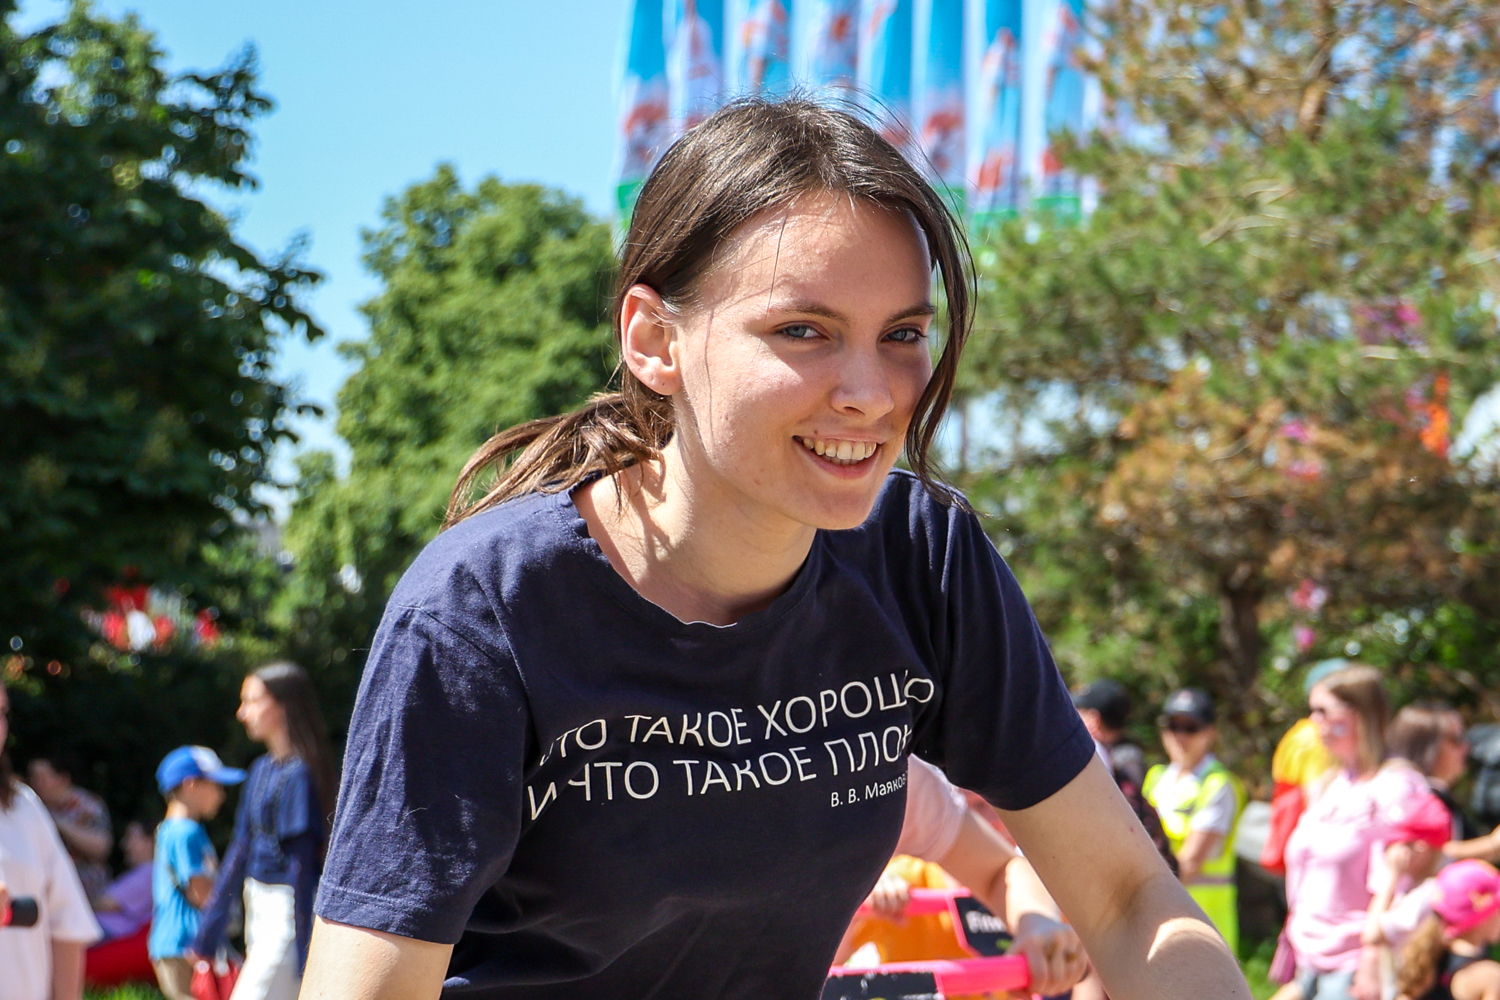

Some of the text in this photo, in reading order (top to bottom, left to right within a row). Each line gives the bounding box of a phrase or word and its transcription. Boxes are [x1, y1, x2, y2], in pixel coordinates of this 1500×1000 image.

[624, 708, 752, 748] ТАКОЕ
[527, 780, 558, 821] И
[567, 760, 660, 802] ЧТО
[672, 746, 817, 796] ТАКОЕ
[830, 791, 844, 808] В.
[847, 788, 861, 805] В.
